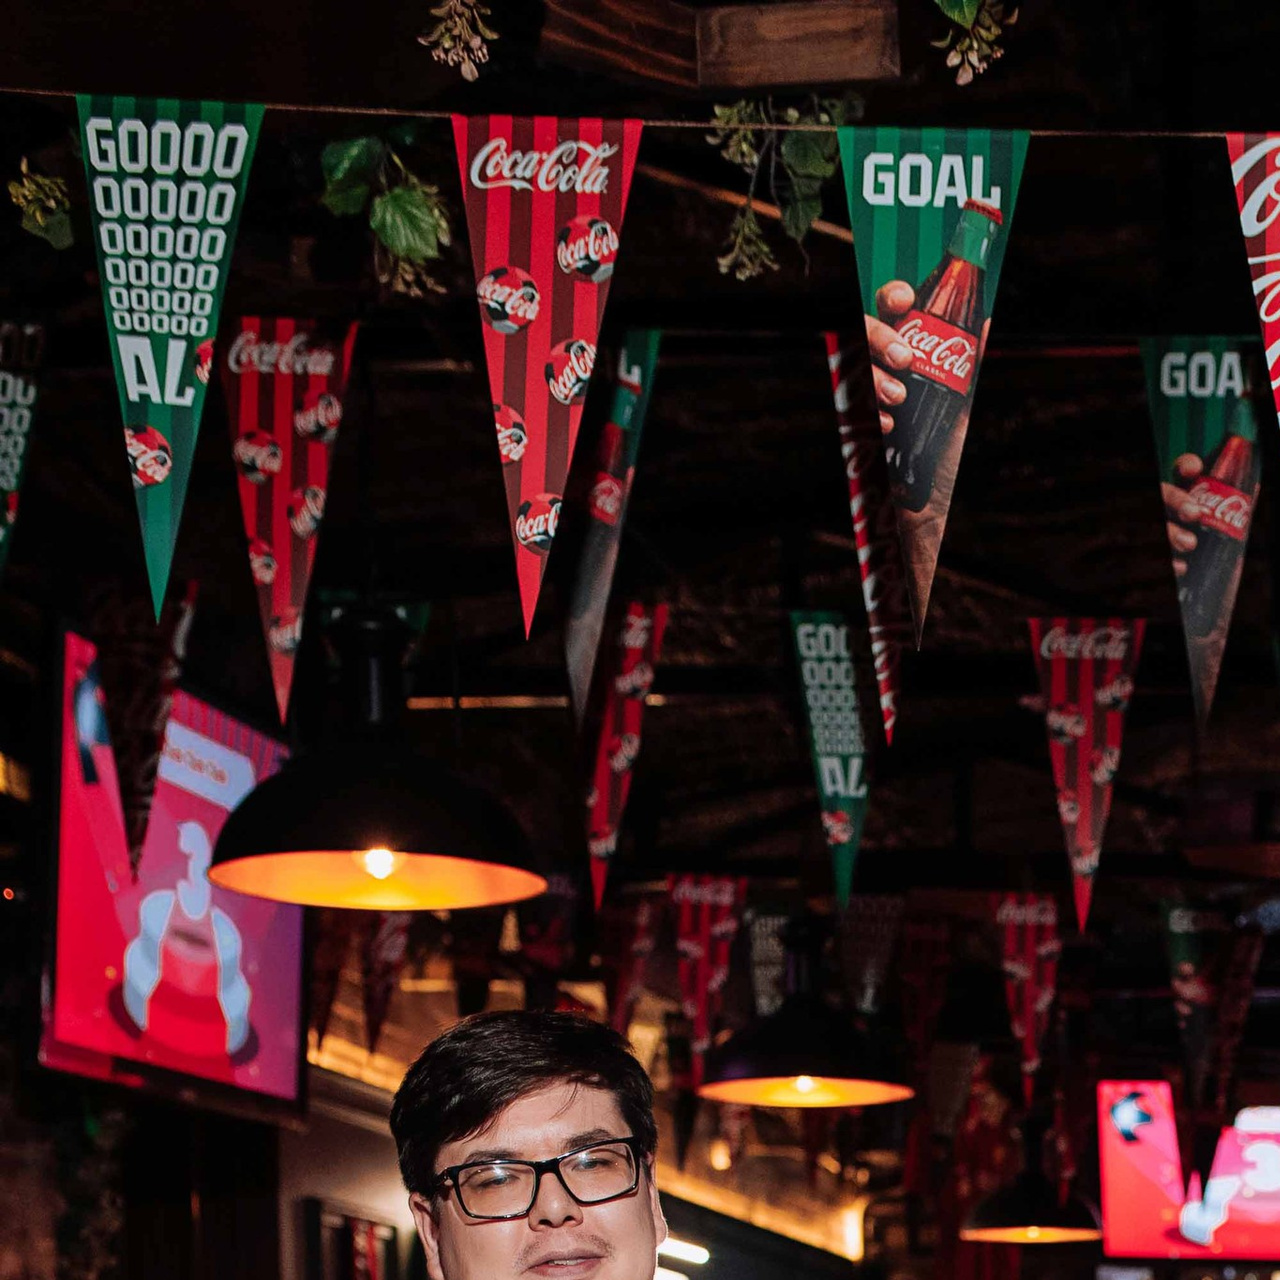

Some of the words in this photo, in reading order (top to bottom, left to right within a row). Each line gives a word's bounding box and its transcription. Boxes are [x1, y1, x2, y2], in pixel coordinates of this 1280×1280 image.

[470, 137, 619, 194] Coca-Cola
[863, 152, 1001, 209] GOAL
[116, 334, 195, 407] AL
[898, 319, 977, 378] Coca-Cola
